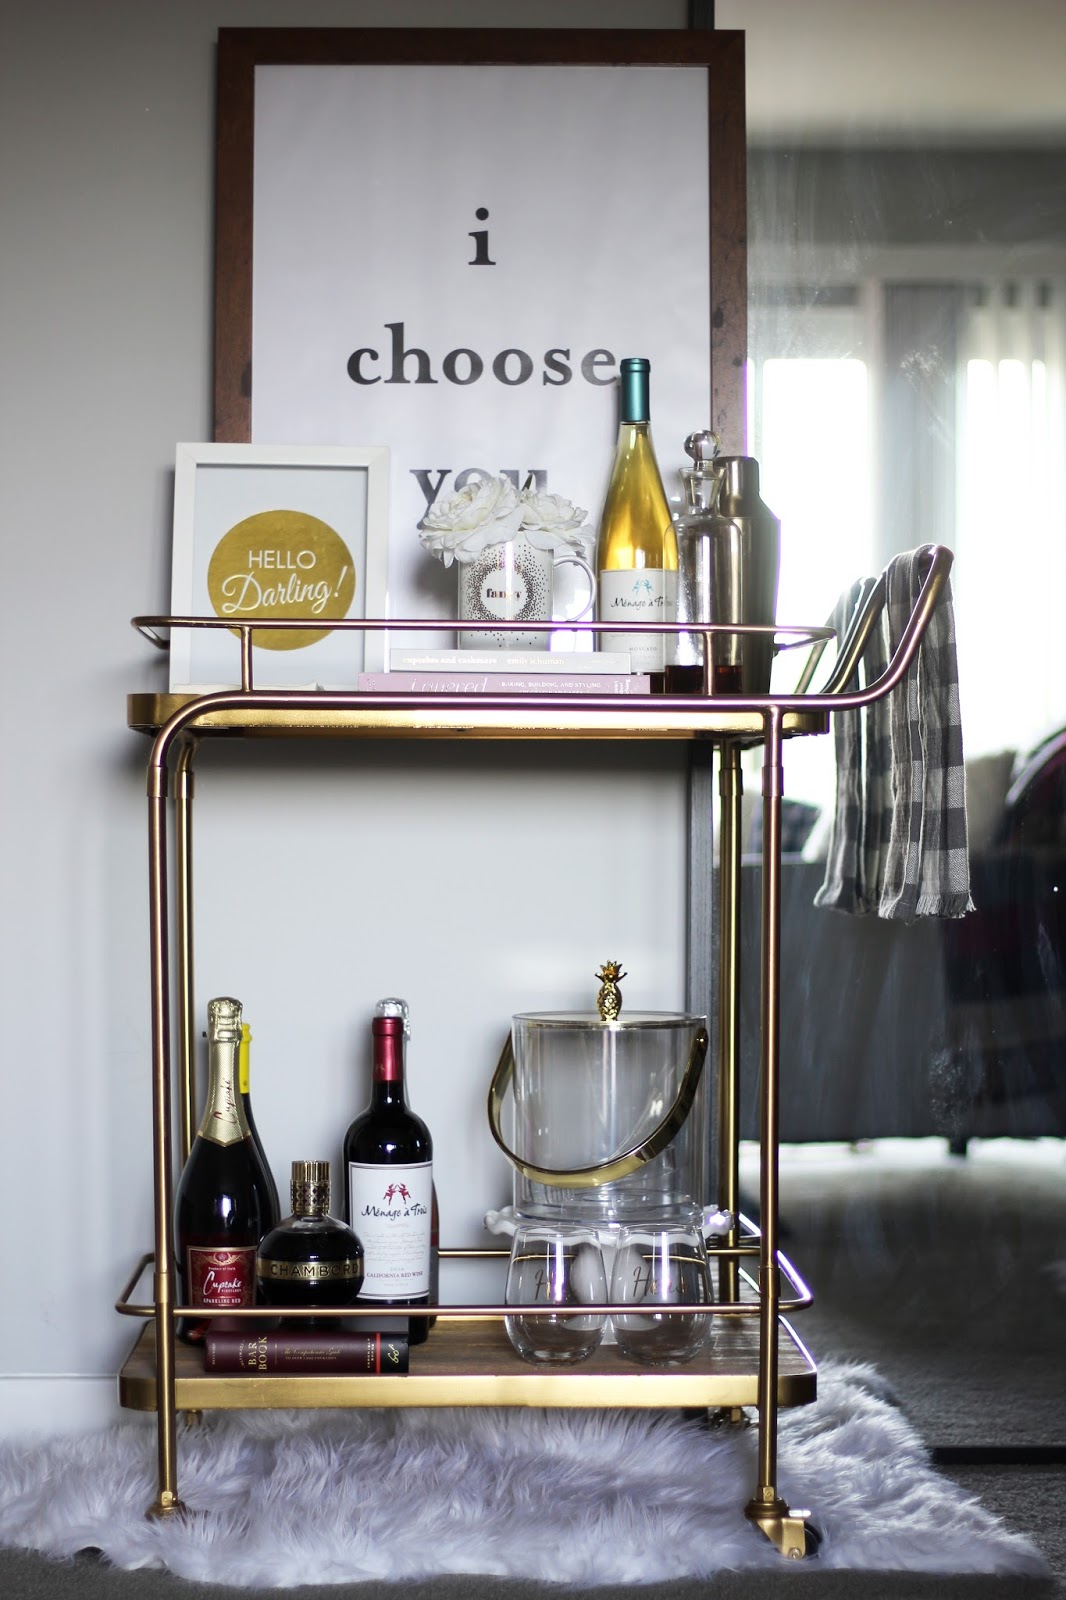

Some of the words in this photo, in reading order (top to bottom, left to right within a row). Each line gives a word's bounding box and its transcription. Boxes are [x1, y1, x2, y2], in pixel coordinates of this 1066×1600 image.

[468, 207, 496, 265] i
[347, 322, 616, 386] choose
[248, 550, 316, 569] HELLO
[222, 566, 348, 613] Darling!
[486, 588, 521, 601] fany
[610, 597, 646, 610] Ménage
[648, 596, 654, 607] à
[403, 656, 439, 666] cupcakes
[440, 656, 456, 665] and
[458, 656, 497, 665] cashmere
[507, 656, 528, 666] emily
[530, 657, 564, 666] schuman
[361, 1205, 401, 1221] Ménage
[404, 1207, 410, 1217] à
[410, 1202, 428, 1216] Trois
[270, 1264, 359, 1277] CHAMBORD
[203, 1271, 242, 1295] Cupcake
[248, 1342, 257, 1365] BAR
[258, 1336, 267, 1370] BOOK
